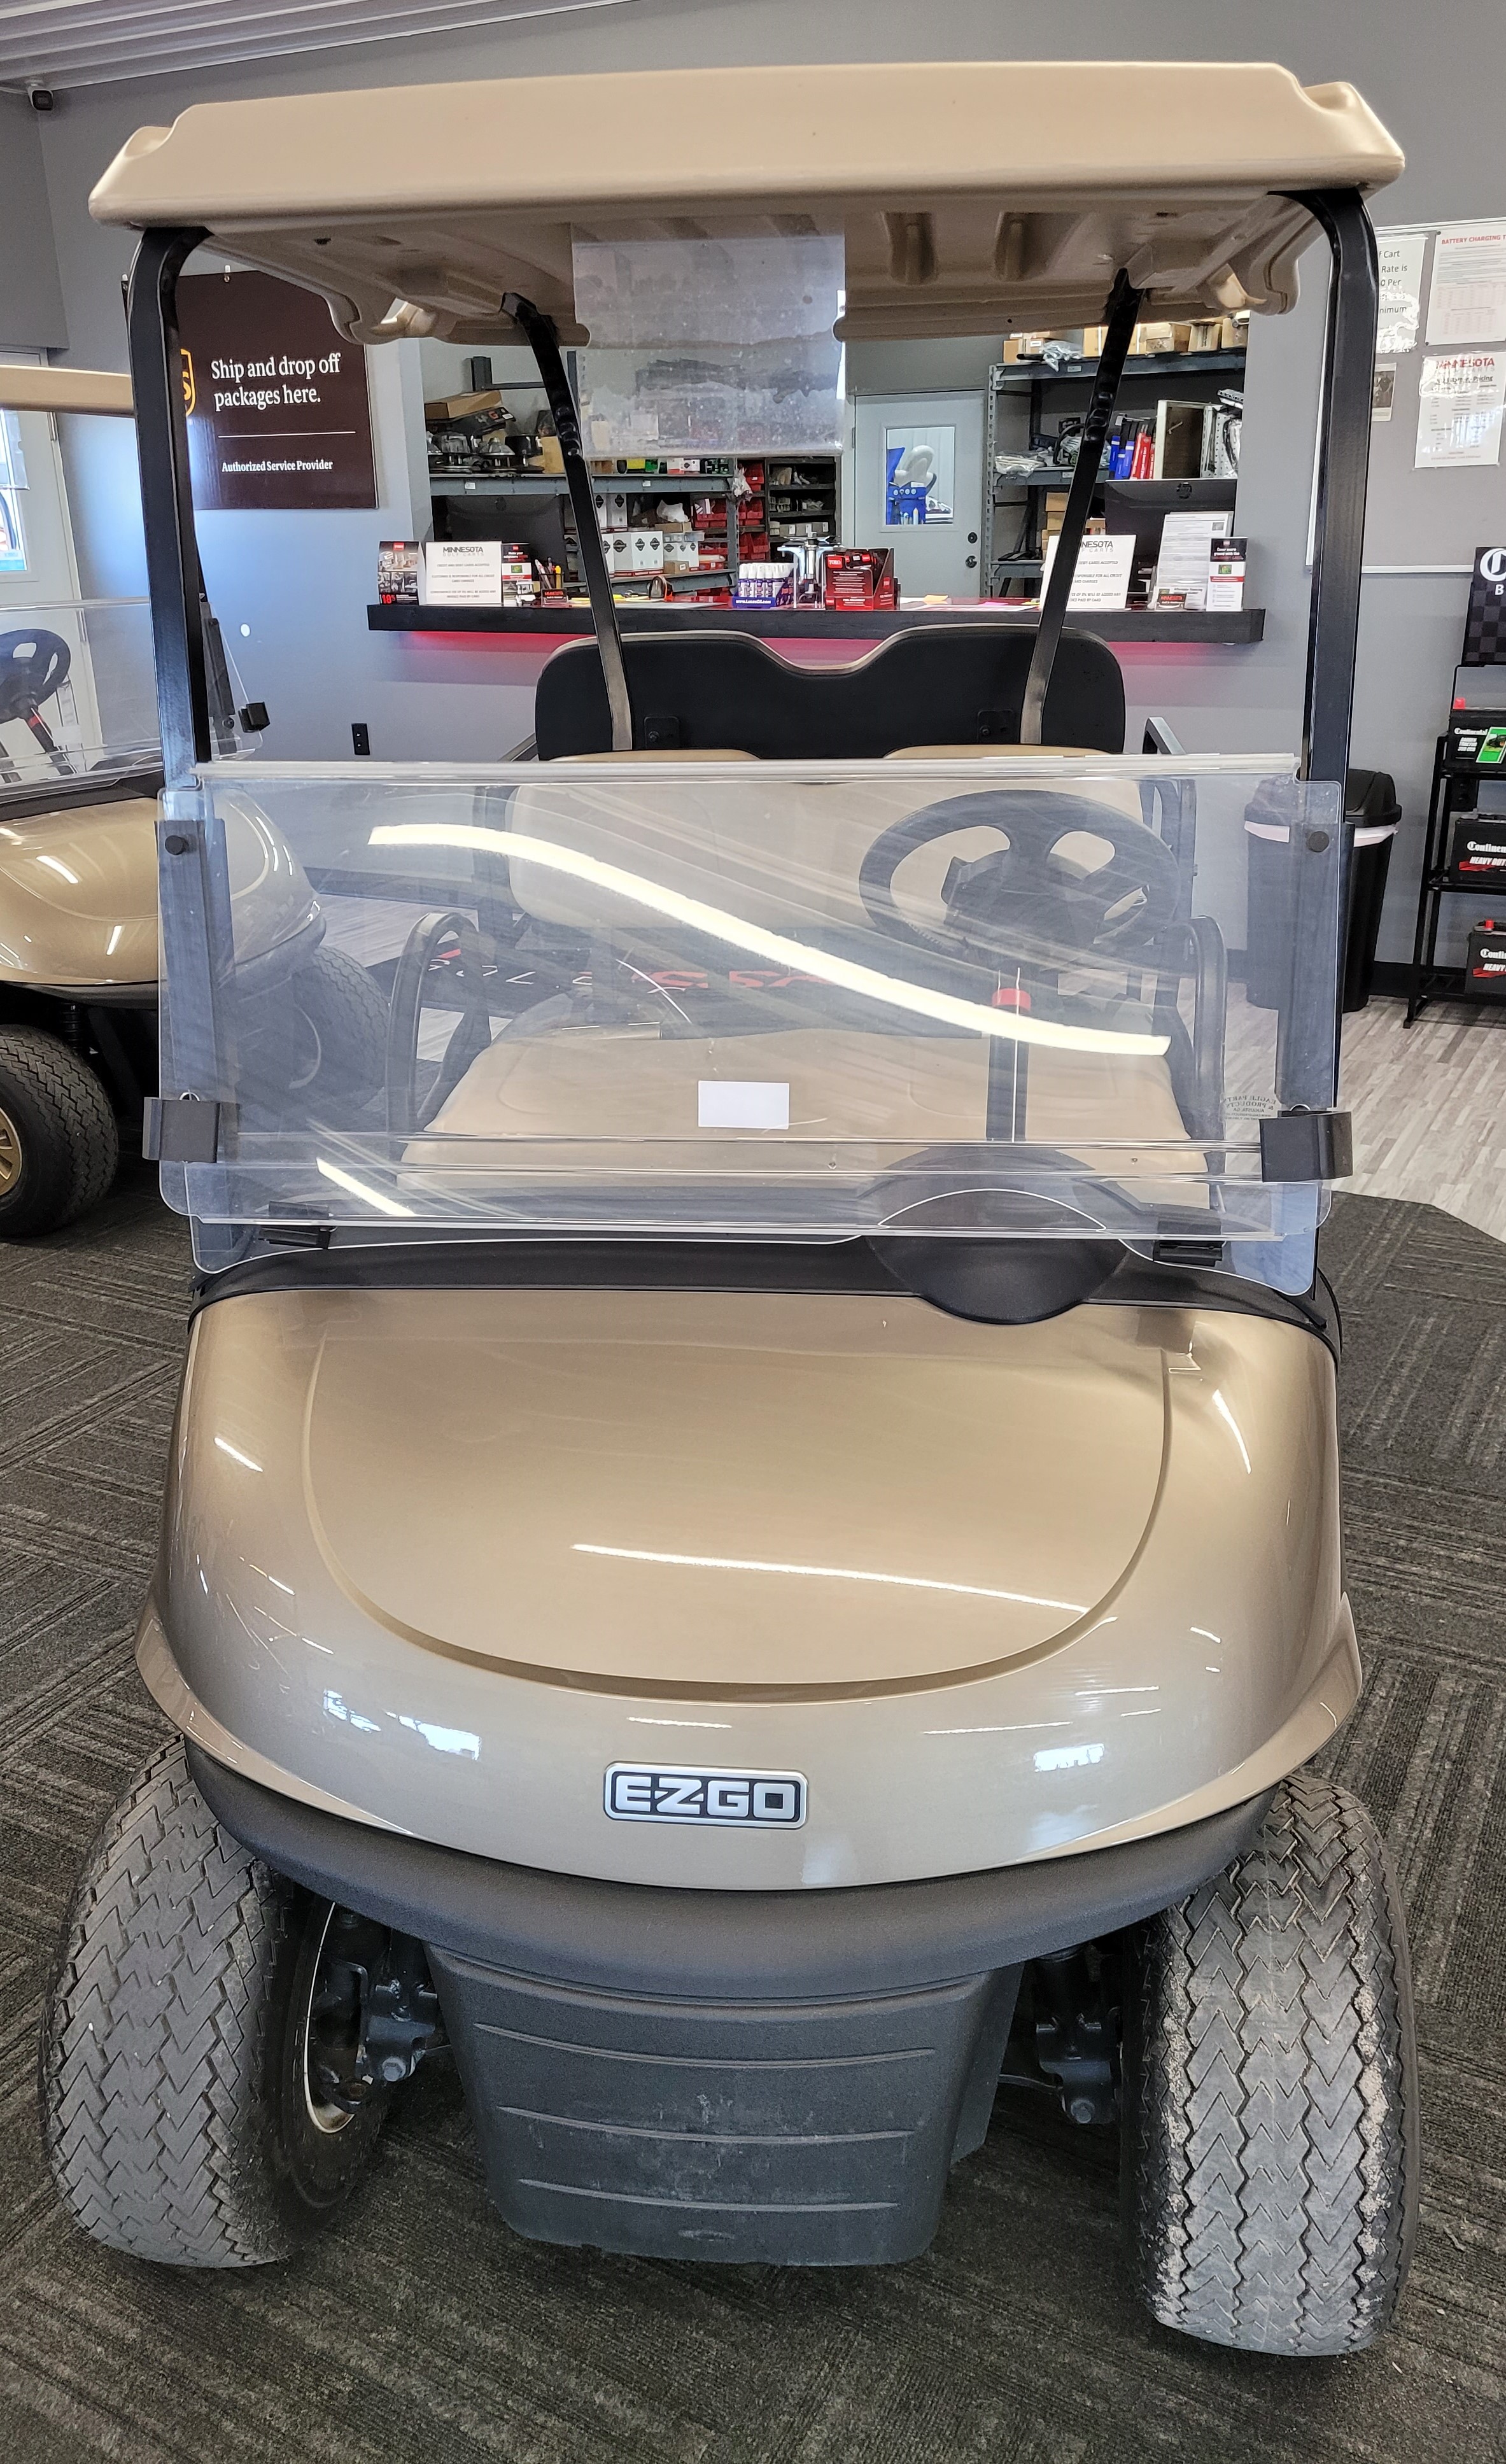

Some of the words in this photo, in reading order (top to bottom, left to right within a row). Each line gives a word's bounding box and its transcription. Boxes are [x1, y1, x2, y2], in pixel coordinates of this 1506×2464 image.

[1383, 250, 1400, 258] Cart
[211, 358, 244, 383] Ship
[247, 356, 277, 377] and
[278, 355, 316, 380] drop
[318, 352, 341, 374] off
[214, 386, 281, 412] packages
[282, 384, 321, 404] here.
[222, 461, 266, 472] Authorized
[267, 460, 296, 471] Service
[297, 458, 334, 470] Provider
[1454, 728, 1489, 736] Continental
[1469, 856, 1493, 865] HEAVY
[1483, 963, 1506, 972] HEAVY
